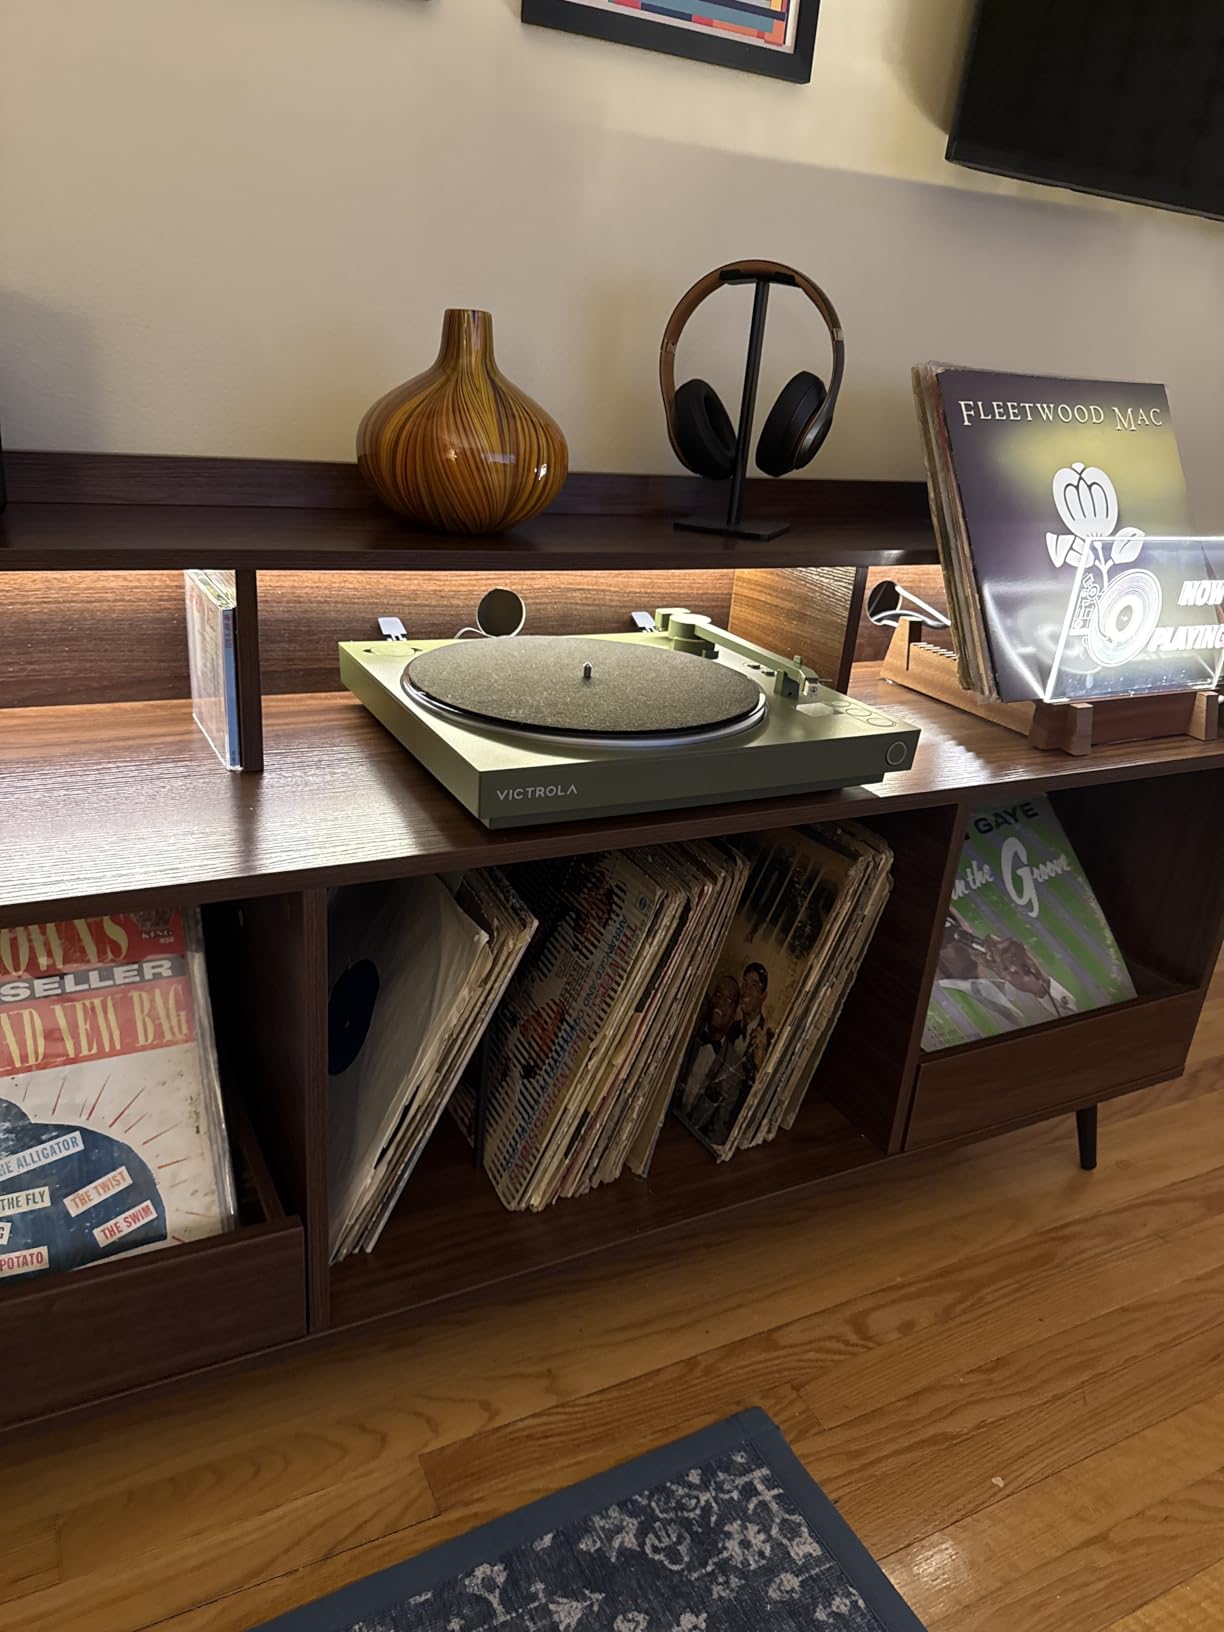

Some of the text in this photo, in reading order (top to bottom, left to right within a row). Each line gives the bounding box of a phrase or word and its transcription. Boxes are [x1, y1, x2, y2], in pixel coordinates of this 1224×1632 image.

[958, 400, 1163, 432] FLEETWOOD MAC
[1177, 580, 1224, 607] NOW
[1146, 624, 1224, 653] PLAYING
[496, 783, 578, 801] VICTROLA
[974, 802, 1038, 834] GAYE
[0, 960, 174, 1002] SELLER
[50, 995, 122, 1058] NEW
[130, 983, 189, 1046] BAG
[16, 1136, 80, 1170] ALLIGATOR
[1, 1190, 46, 1211] THE FLY
[70, 1170, 127, 1209] THE TWIST
[101, 1204, 154, 1240] THE SWIM
[0, 1251, 44, 1272] POTATO
